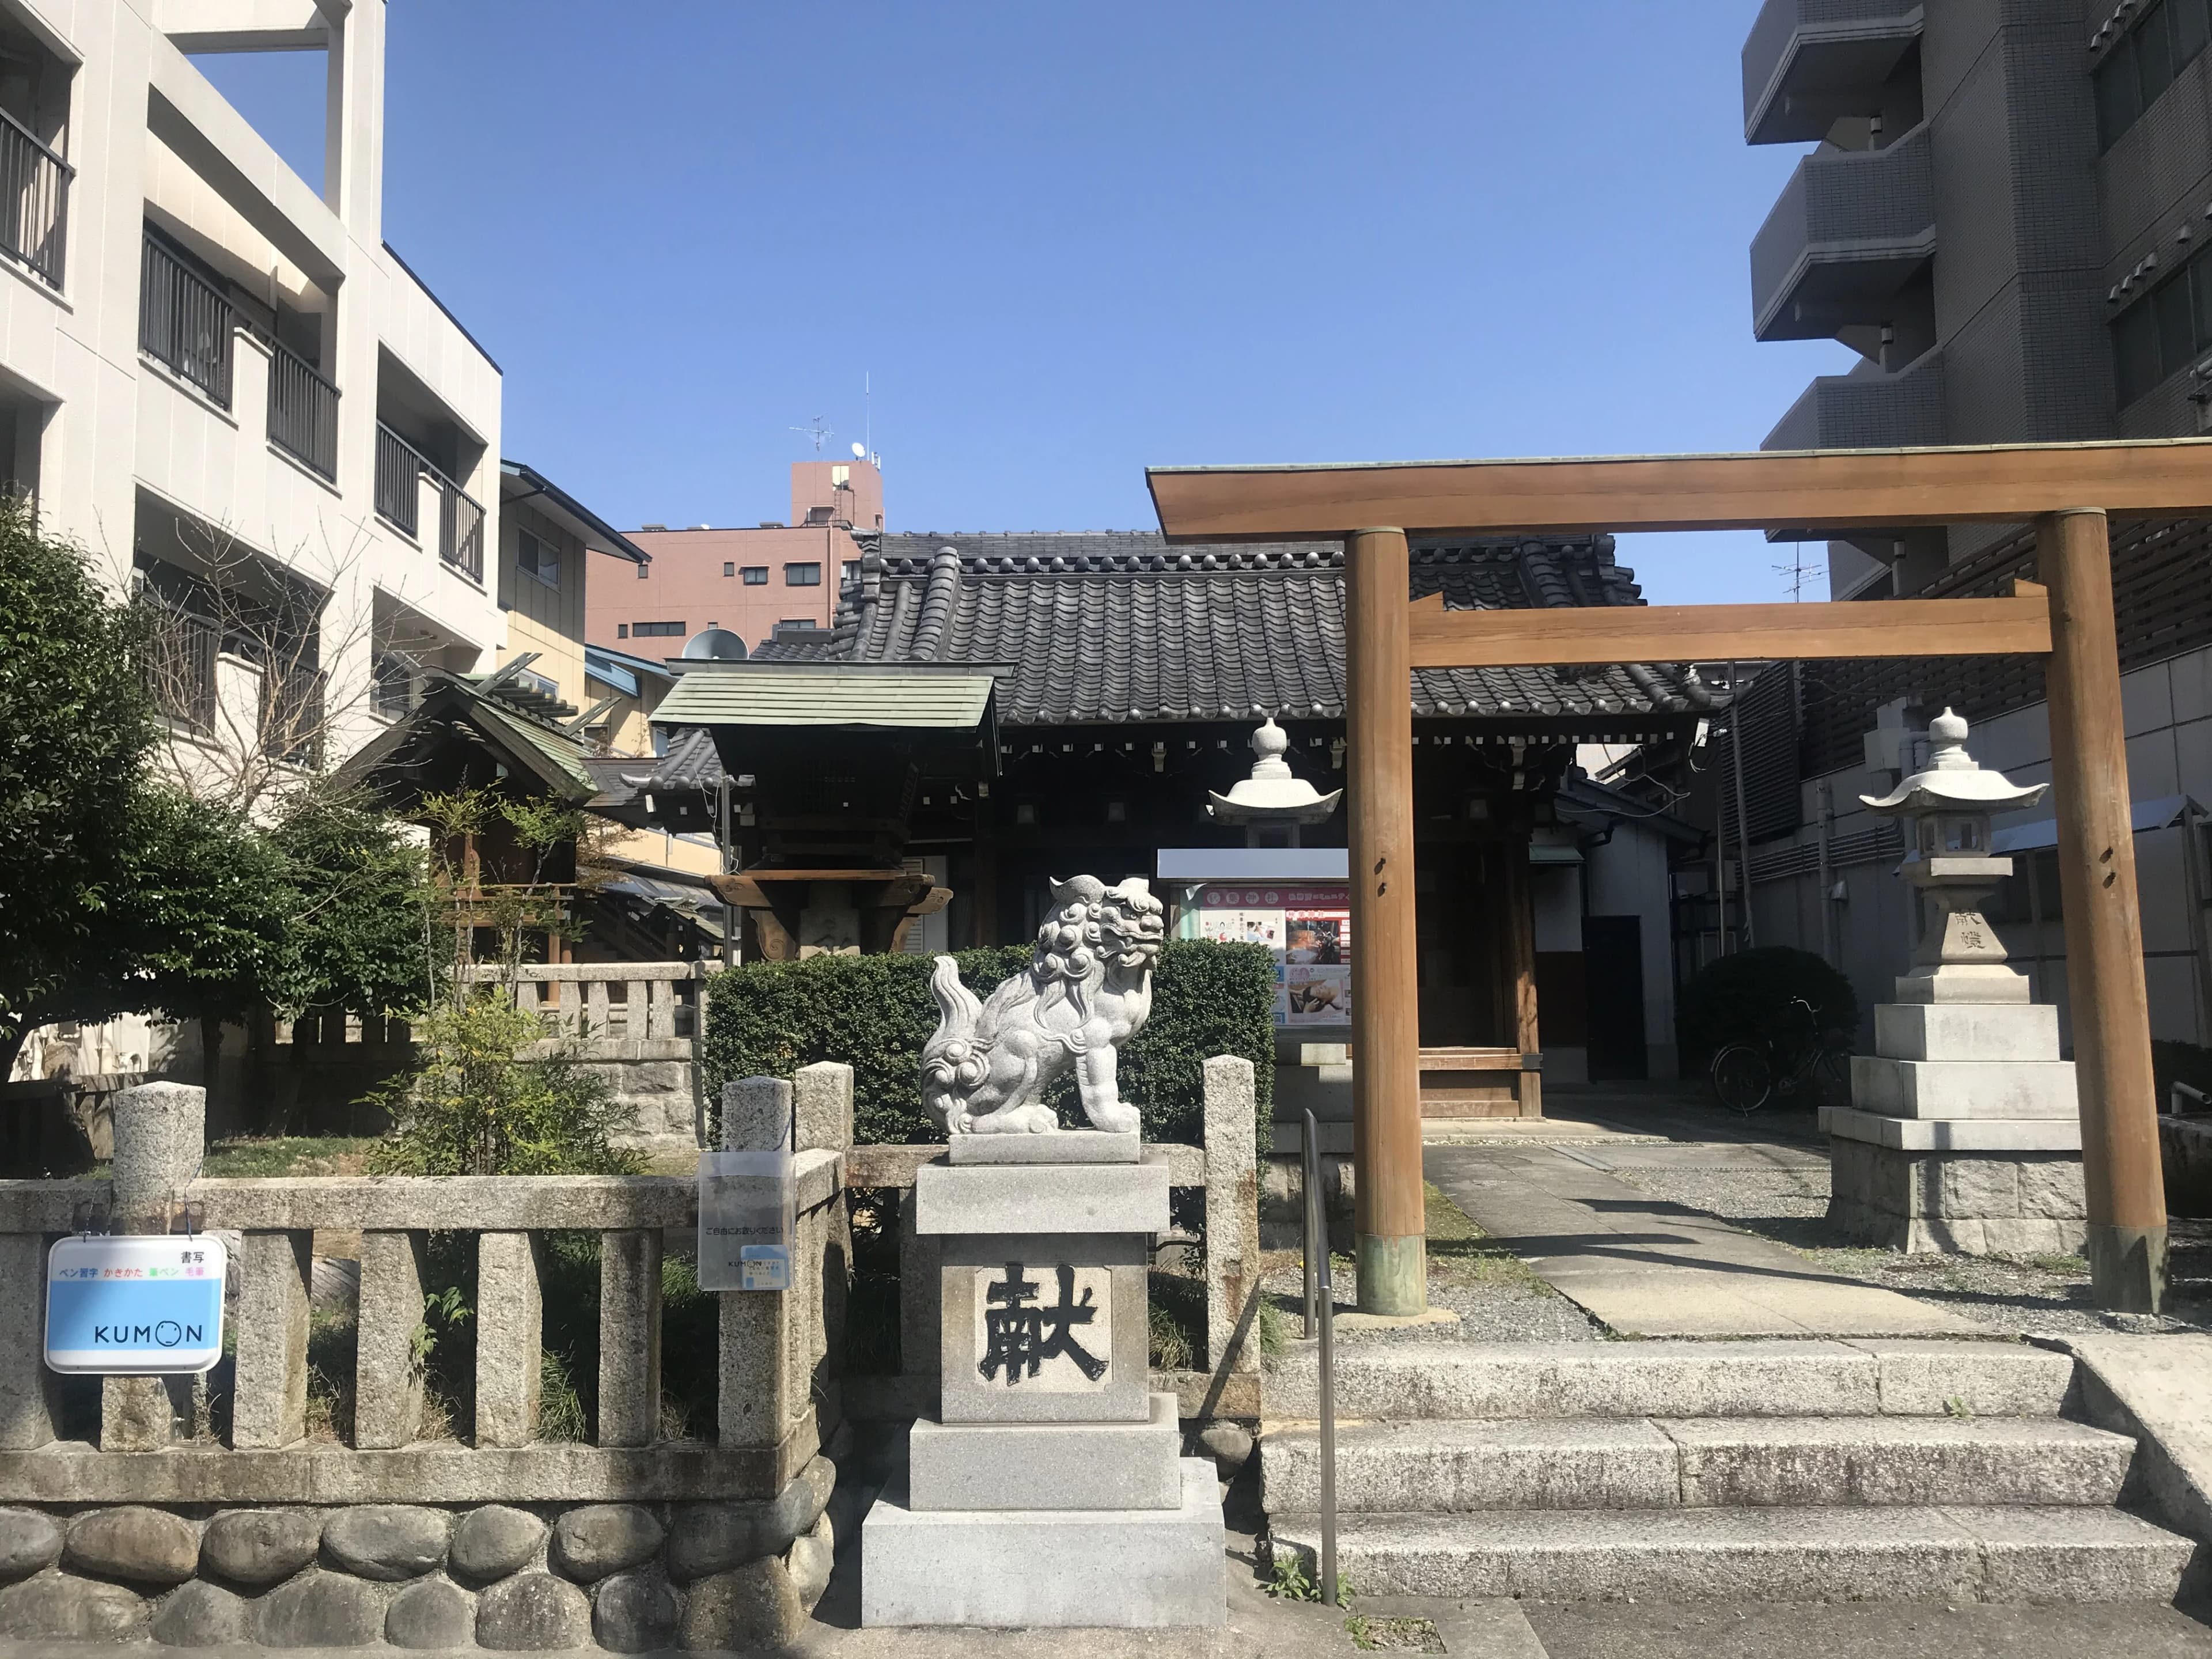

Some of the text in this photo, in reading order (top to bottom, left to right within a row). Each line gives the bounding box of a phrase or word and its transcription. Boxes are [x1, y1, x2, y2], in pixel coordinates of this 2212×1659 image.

[706, 1226, 783, 1236] ご自由にお取りください
[180, 1251, 204, 1263] 書写
[728, 1259, 762, 1268] KUMON
[59, 1267, 204, 1278] ペン習字 かきかた 筆ペン 毛筆
[978, 1262, 1109, 1387] 献
[94, 1321, 202, 1347] KUMON
